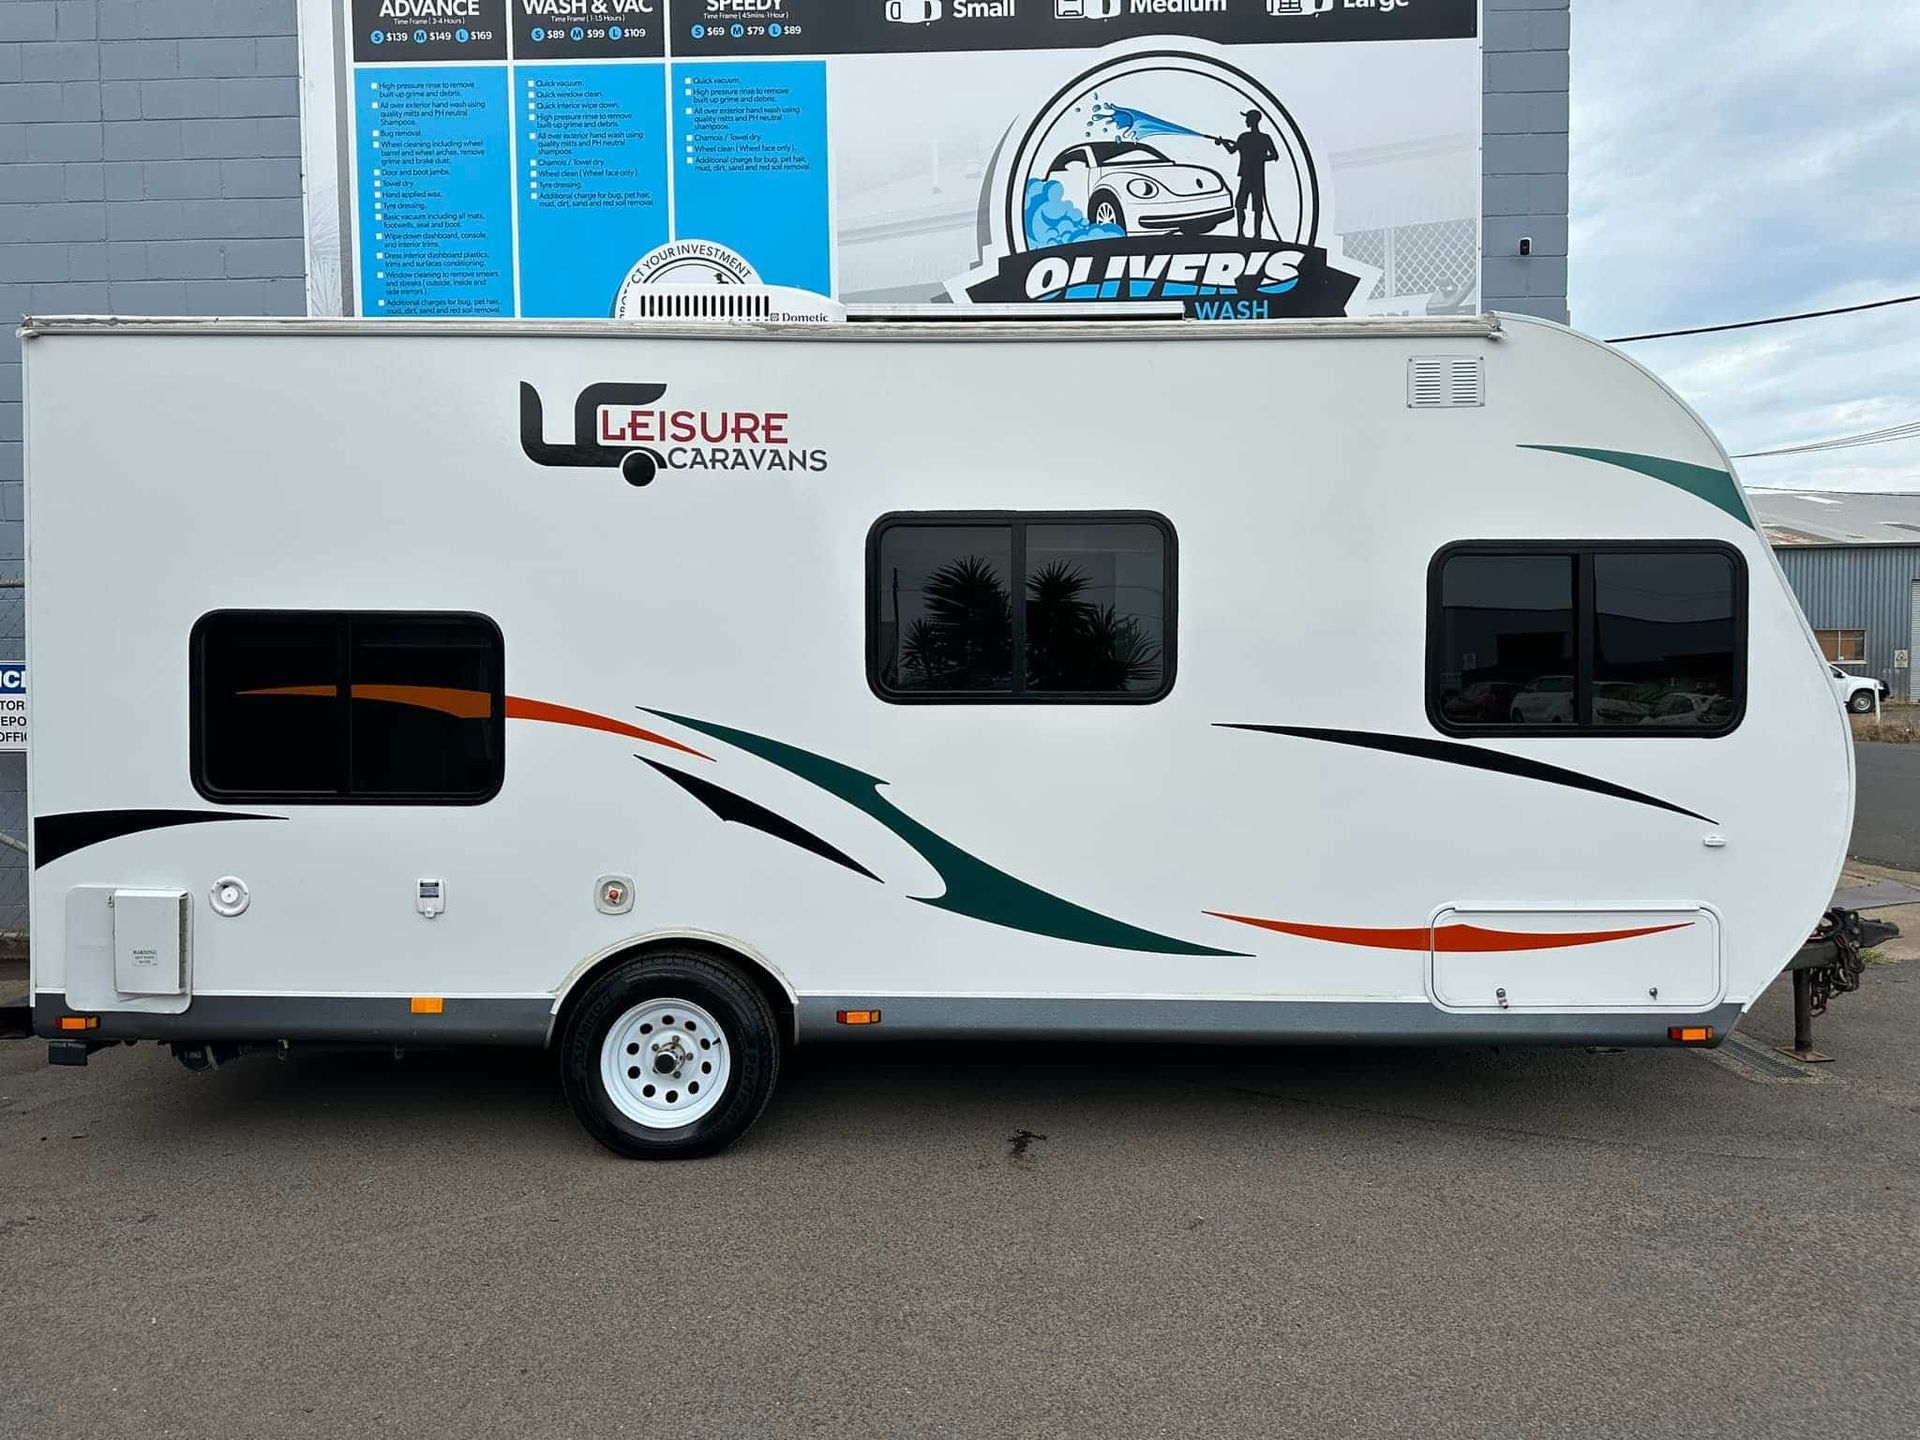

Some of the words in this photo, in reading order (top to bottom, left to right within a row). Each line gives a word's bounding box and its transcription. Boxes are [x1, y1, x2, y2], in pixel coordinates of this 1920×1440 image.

[379, 0, 480, 17] ADVANCE
[522, 0, 586, 14] WASH
[591, 0, 608, 13] &
[612, 0, 653, 13] VAC
[706, 0, 781, 11] SPEEDY
[953, 0, 1015, 18] Small
[1130, 0, 1227, 14] Medium
[386, 32, 408, 42] $139
[430, 32, 452, 41] $149
[470, 31, 492, 40] $169
[547, 30, 565, 40] $89
[587, 29, 605, 38] $99
[624, 28, 646, 38] $109
[707, 26, 725, 36] $69
[746, 26, 764, 36] $79
[784, 26, 802, 34] $89
[642, 247, 676, 270] YOUR
[676, 243, 752, 279] INVESTMENT
[1025, 250, 1305, 300] OLIVER'S
[782, 312, 829, 322] Dometic
[1194, 299, 1268, 320] WASH
[601, 410, 789, 444] LEISURE
[667, 446, 828, 472] CARAVANS
